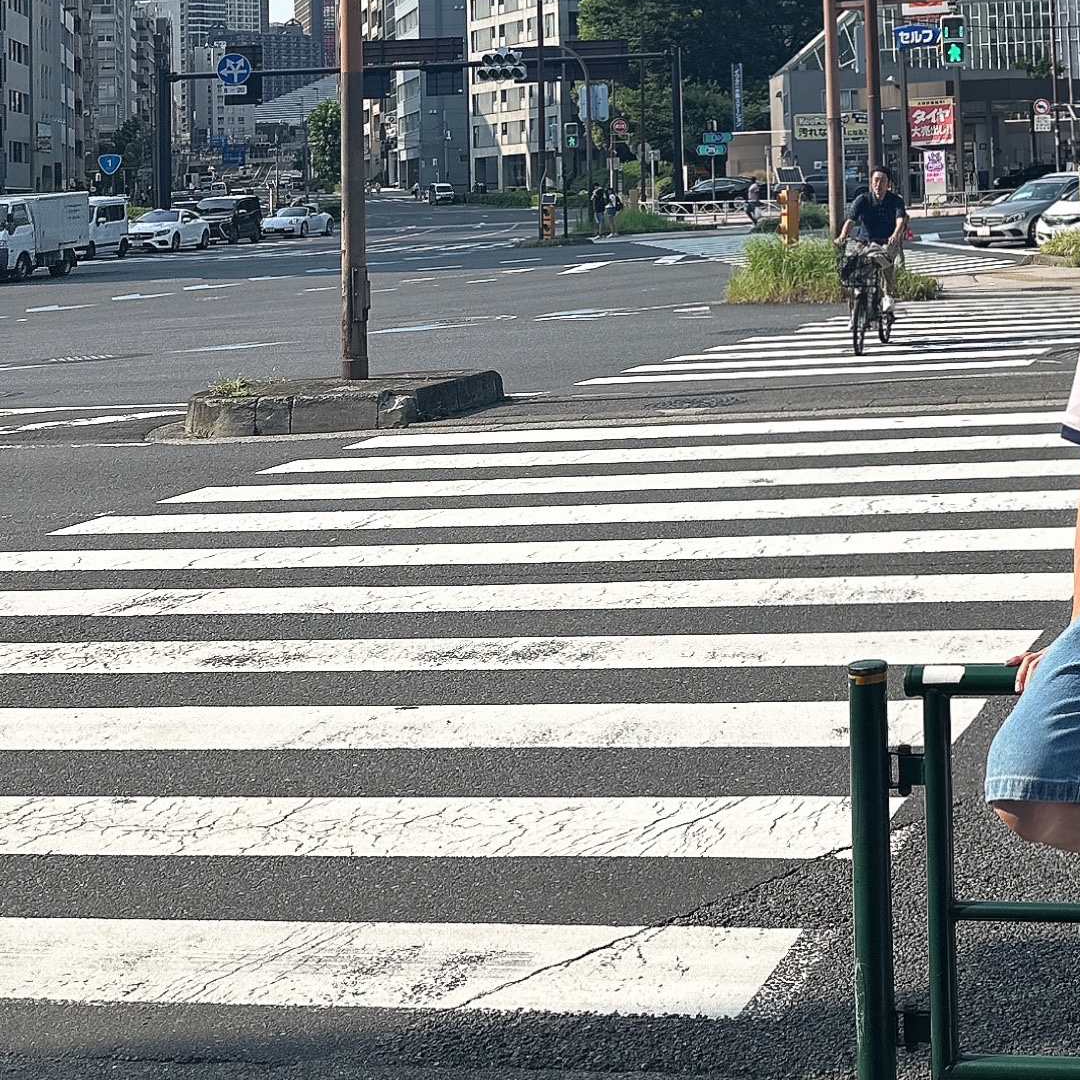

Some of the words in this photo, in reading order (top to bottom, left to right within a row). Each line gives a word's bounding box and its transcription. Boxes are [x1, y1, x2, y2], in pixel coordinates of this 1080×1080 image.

[898, 29, 934, 45] セルフ
[911, 107, 950, 125] タイヤ
[106, 159, 112, 167] 1
